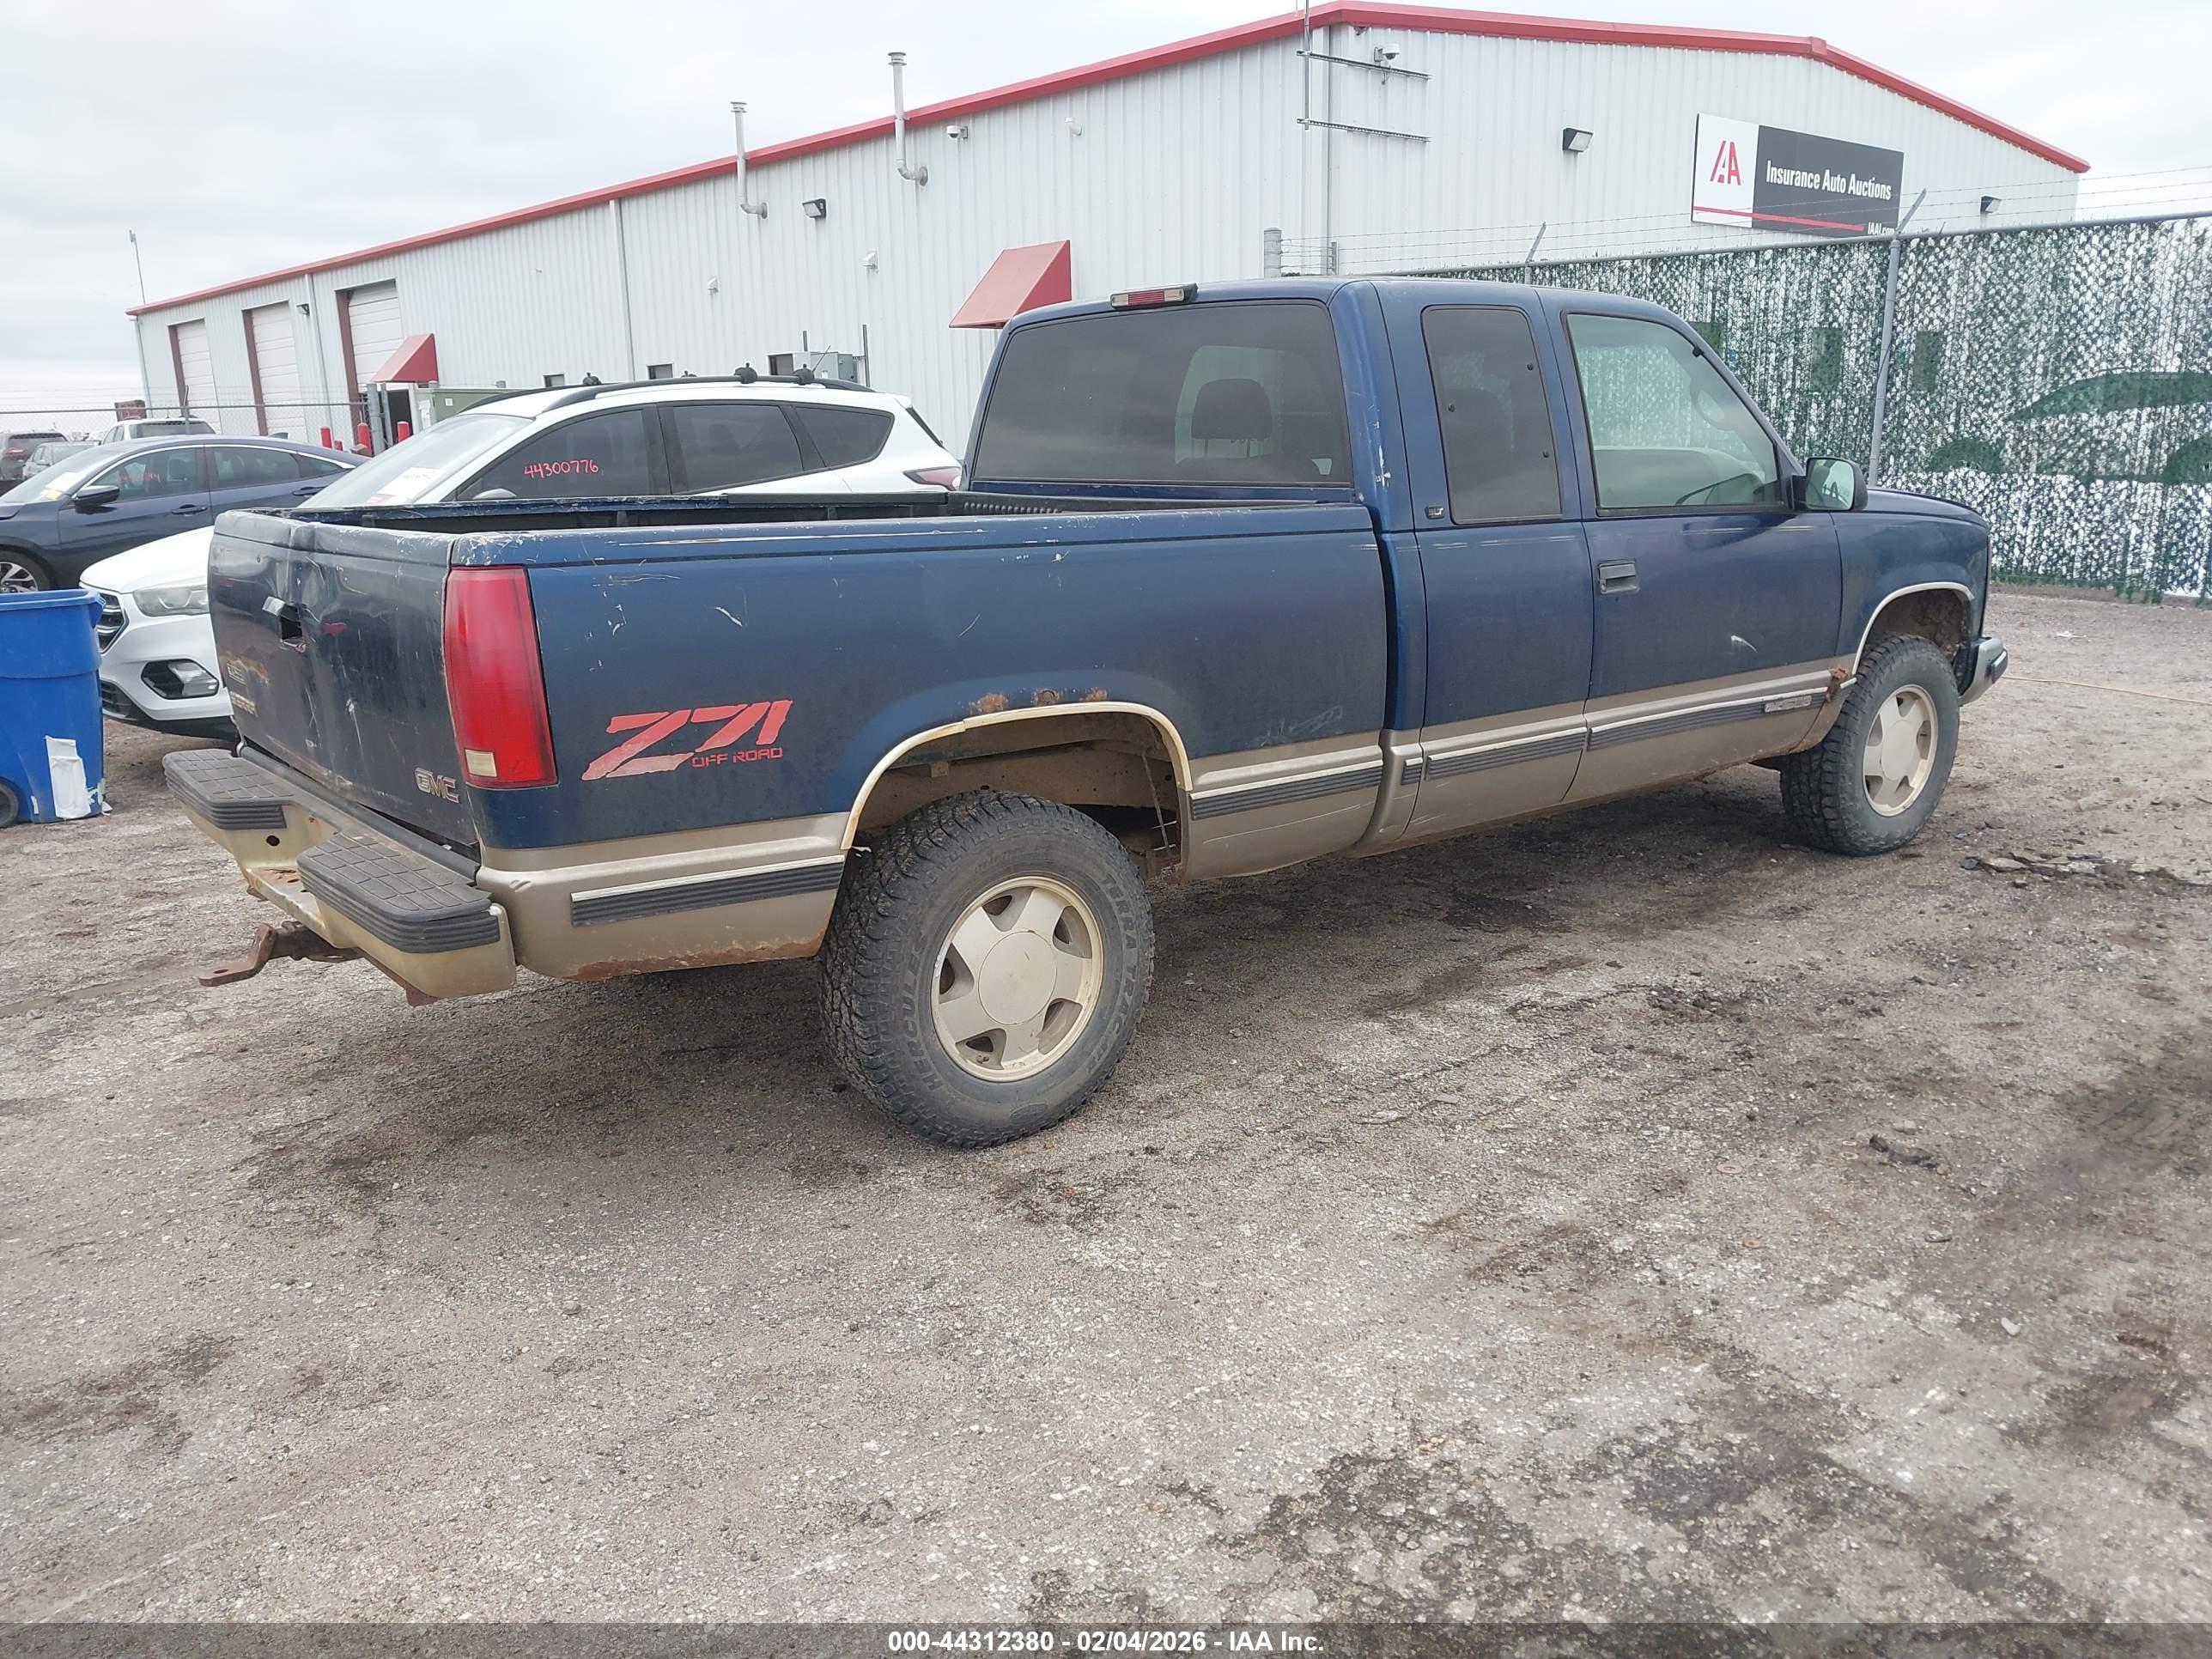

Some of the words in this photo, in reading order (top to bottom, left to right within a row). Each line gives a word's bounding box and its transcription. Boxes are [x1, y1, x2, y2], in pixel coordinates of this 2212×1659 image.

[1765, 160, 1820, 191] Insurance
[1821, 169, 1847, 194] Auto
[1847, 173, 1893, 201] Auctions
[524, 459, 599, 479] 44300776
[580, 700, 793, 781] Z71
[691, 753, 729, 769] OFF
[732, 747, 784, 763] ROAD
[414, 766, 460, 804] GMC
[902, 929, 945, 1092] HERCULES
